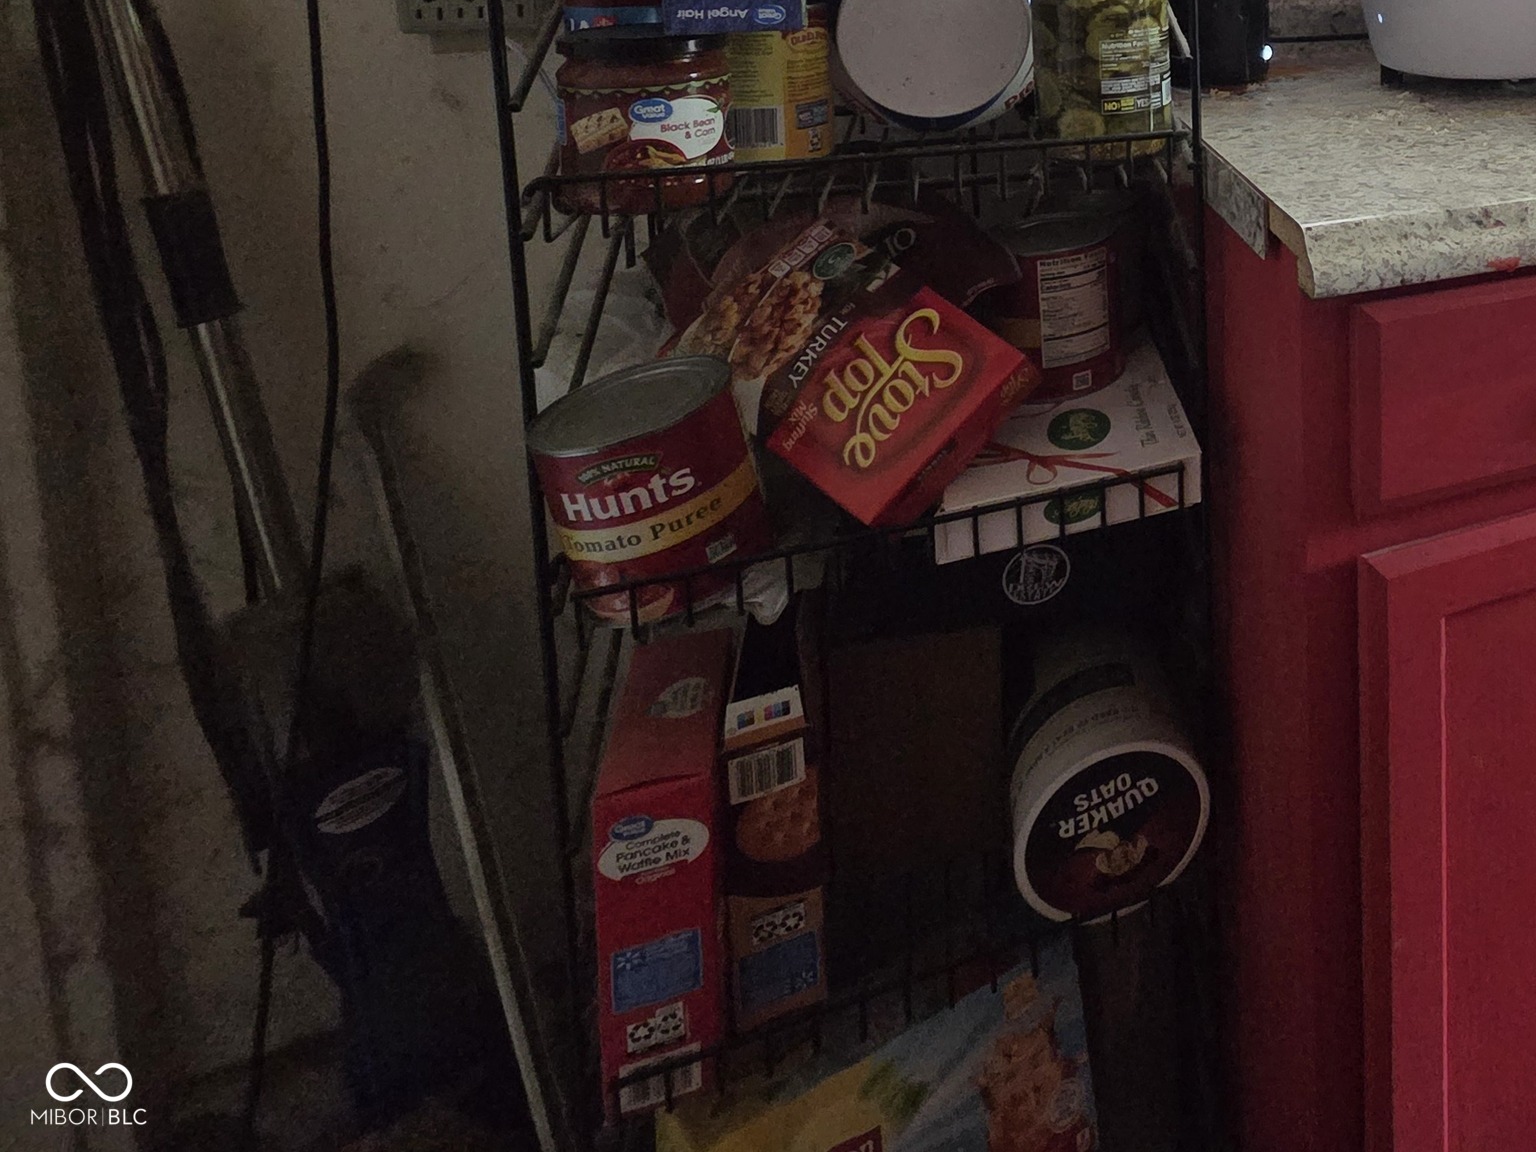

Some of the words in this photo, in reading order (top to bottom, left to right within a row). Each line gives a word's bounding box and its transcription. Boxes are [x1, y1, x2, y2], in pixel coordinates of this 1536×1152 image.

[676, 8, 705, 21] Hair
[707, 6, 749, 20] Angel
[633, 103, 666, 115] Great
[660, 121, 691, 133] Black
[693, 117, 716, 129] Bean
[684, 131, 692, 140] &
[787, 315, 849, 390] TURKEY
[822, 332, 898, 424] Top
[842, 307, 964, 469] Stove
[600, 454, 657, 473] NATURAL
[561, 533, 643, 554] Tomato
[649, 494, 723, 543] Puree
[1072, 772, 1134, 813] OATS
[1056, 776, 1161, 840] QUAKER
[615, 840, 679, 863] Pancake
[681, 834, 691, 846] &
[625, 830, 682, 851] Complete
[617, 856, 662, 874] Waffle
[664, 847, 691, 862] Mix
